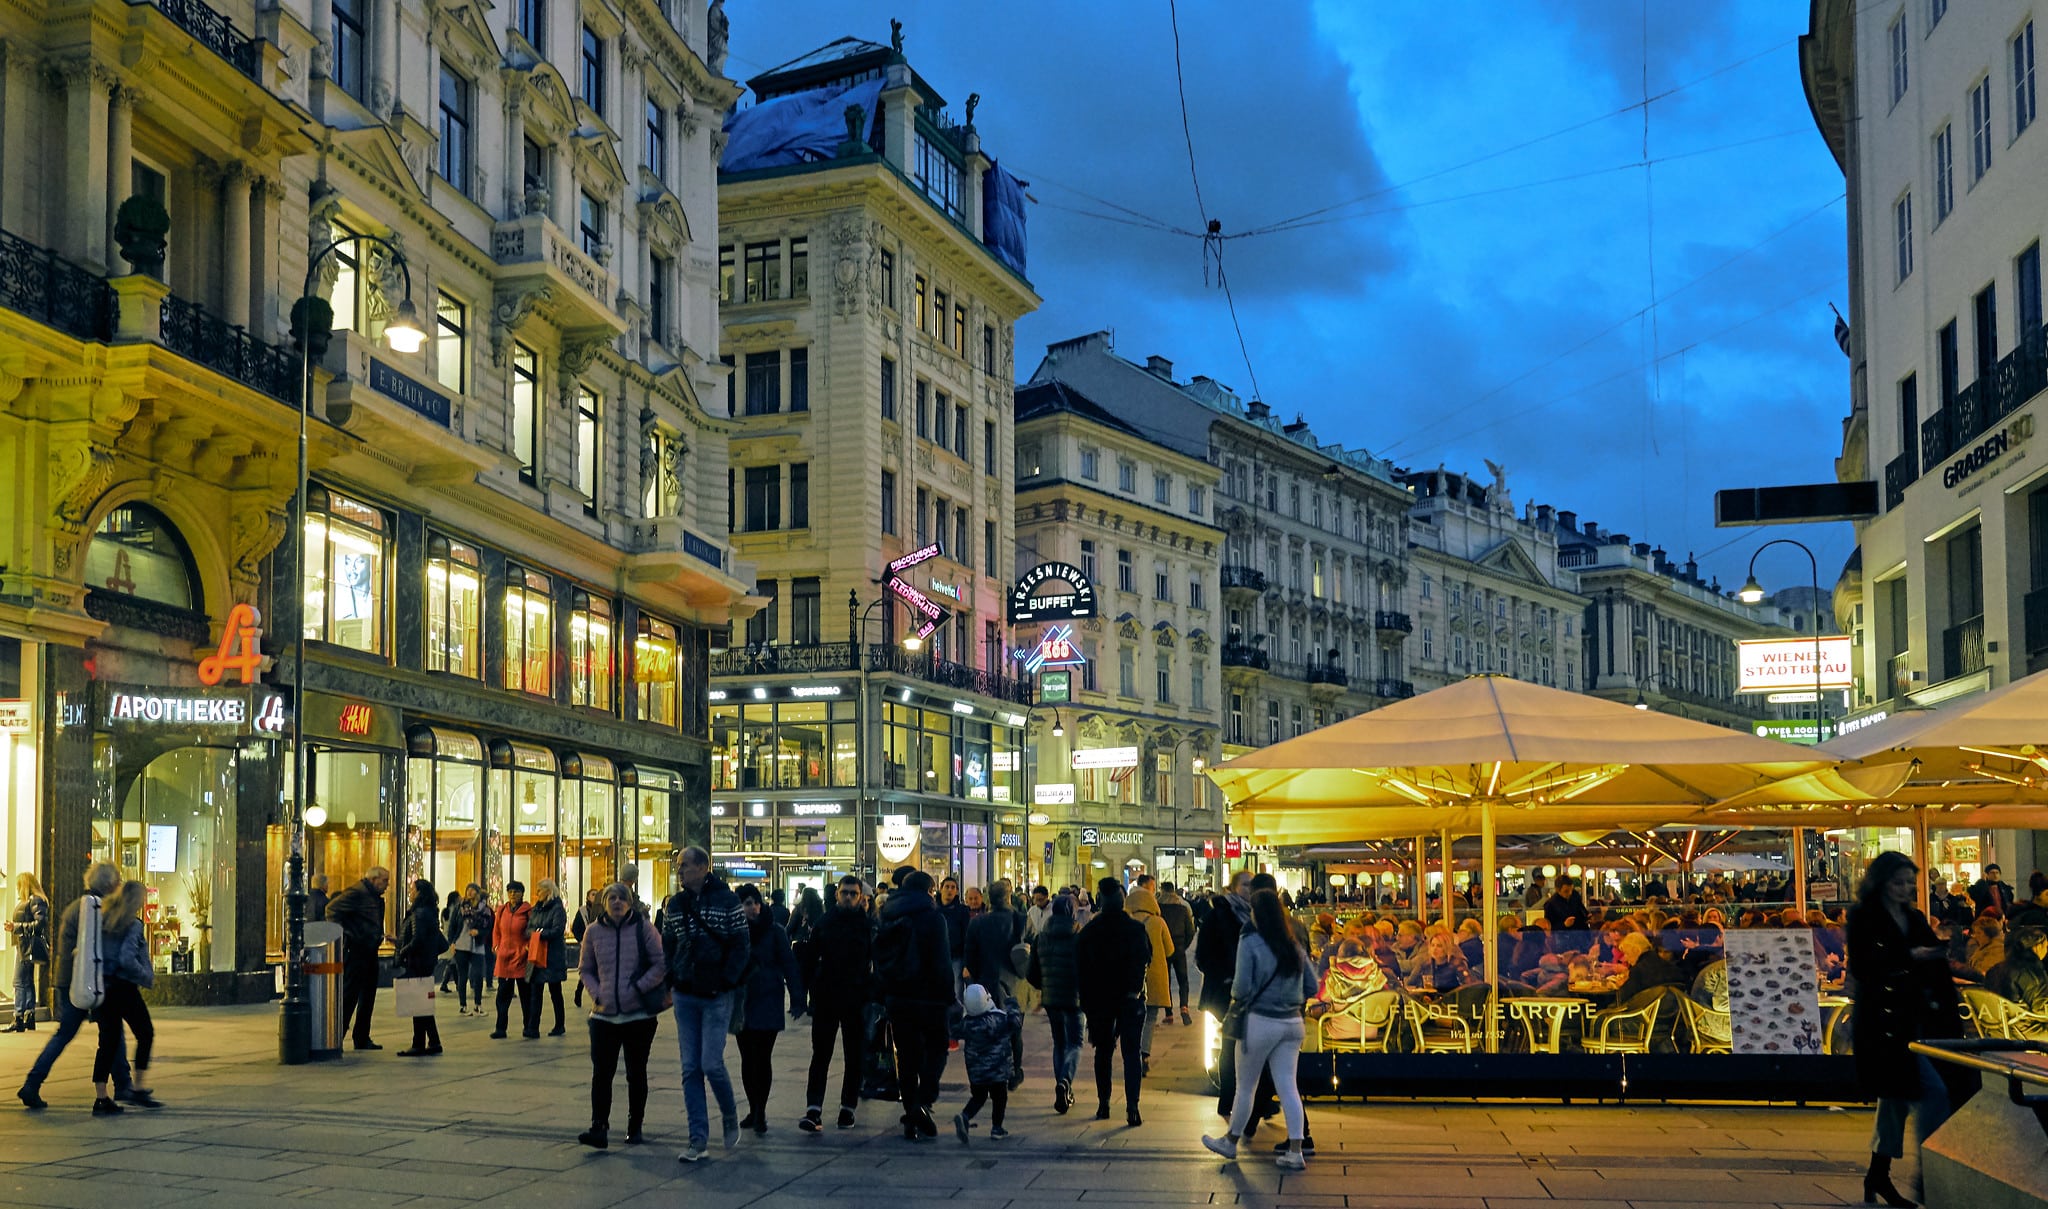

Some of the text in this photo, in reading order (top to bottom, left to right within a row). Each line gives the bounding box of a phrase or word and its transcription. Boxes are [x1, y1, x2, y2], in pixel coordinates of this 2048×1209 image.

[391, 375, 423, 407] BRAUN
[890, 544, 938, 569] DISCOTHEQUE
[1015, 563, 1091, 609] TRZESNIEWSKI
[889, 578, 940, 620] FLEDERMAUS
[1029, 596, 1075, 610] BUFFET
[114, 695, 244, 723] APOTHEKE
[1001, 834, 1021, 846] FOSSIL
[1429, 1003, 1458, 1019] DE
[1450, 1030, 1471, 1040] Wie
